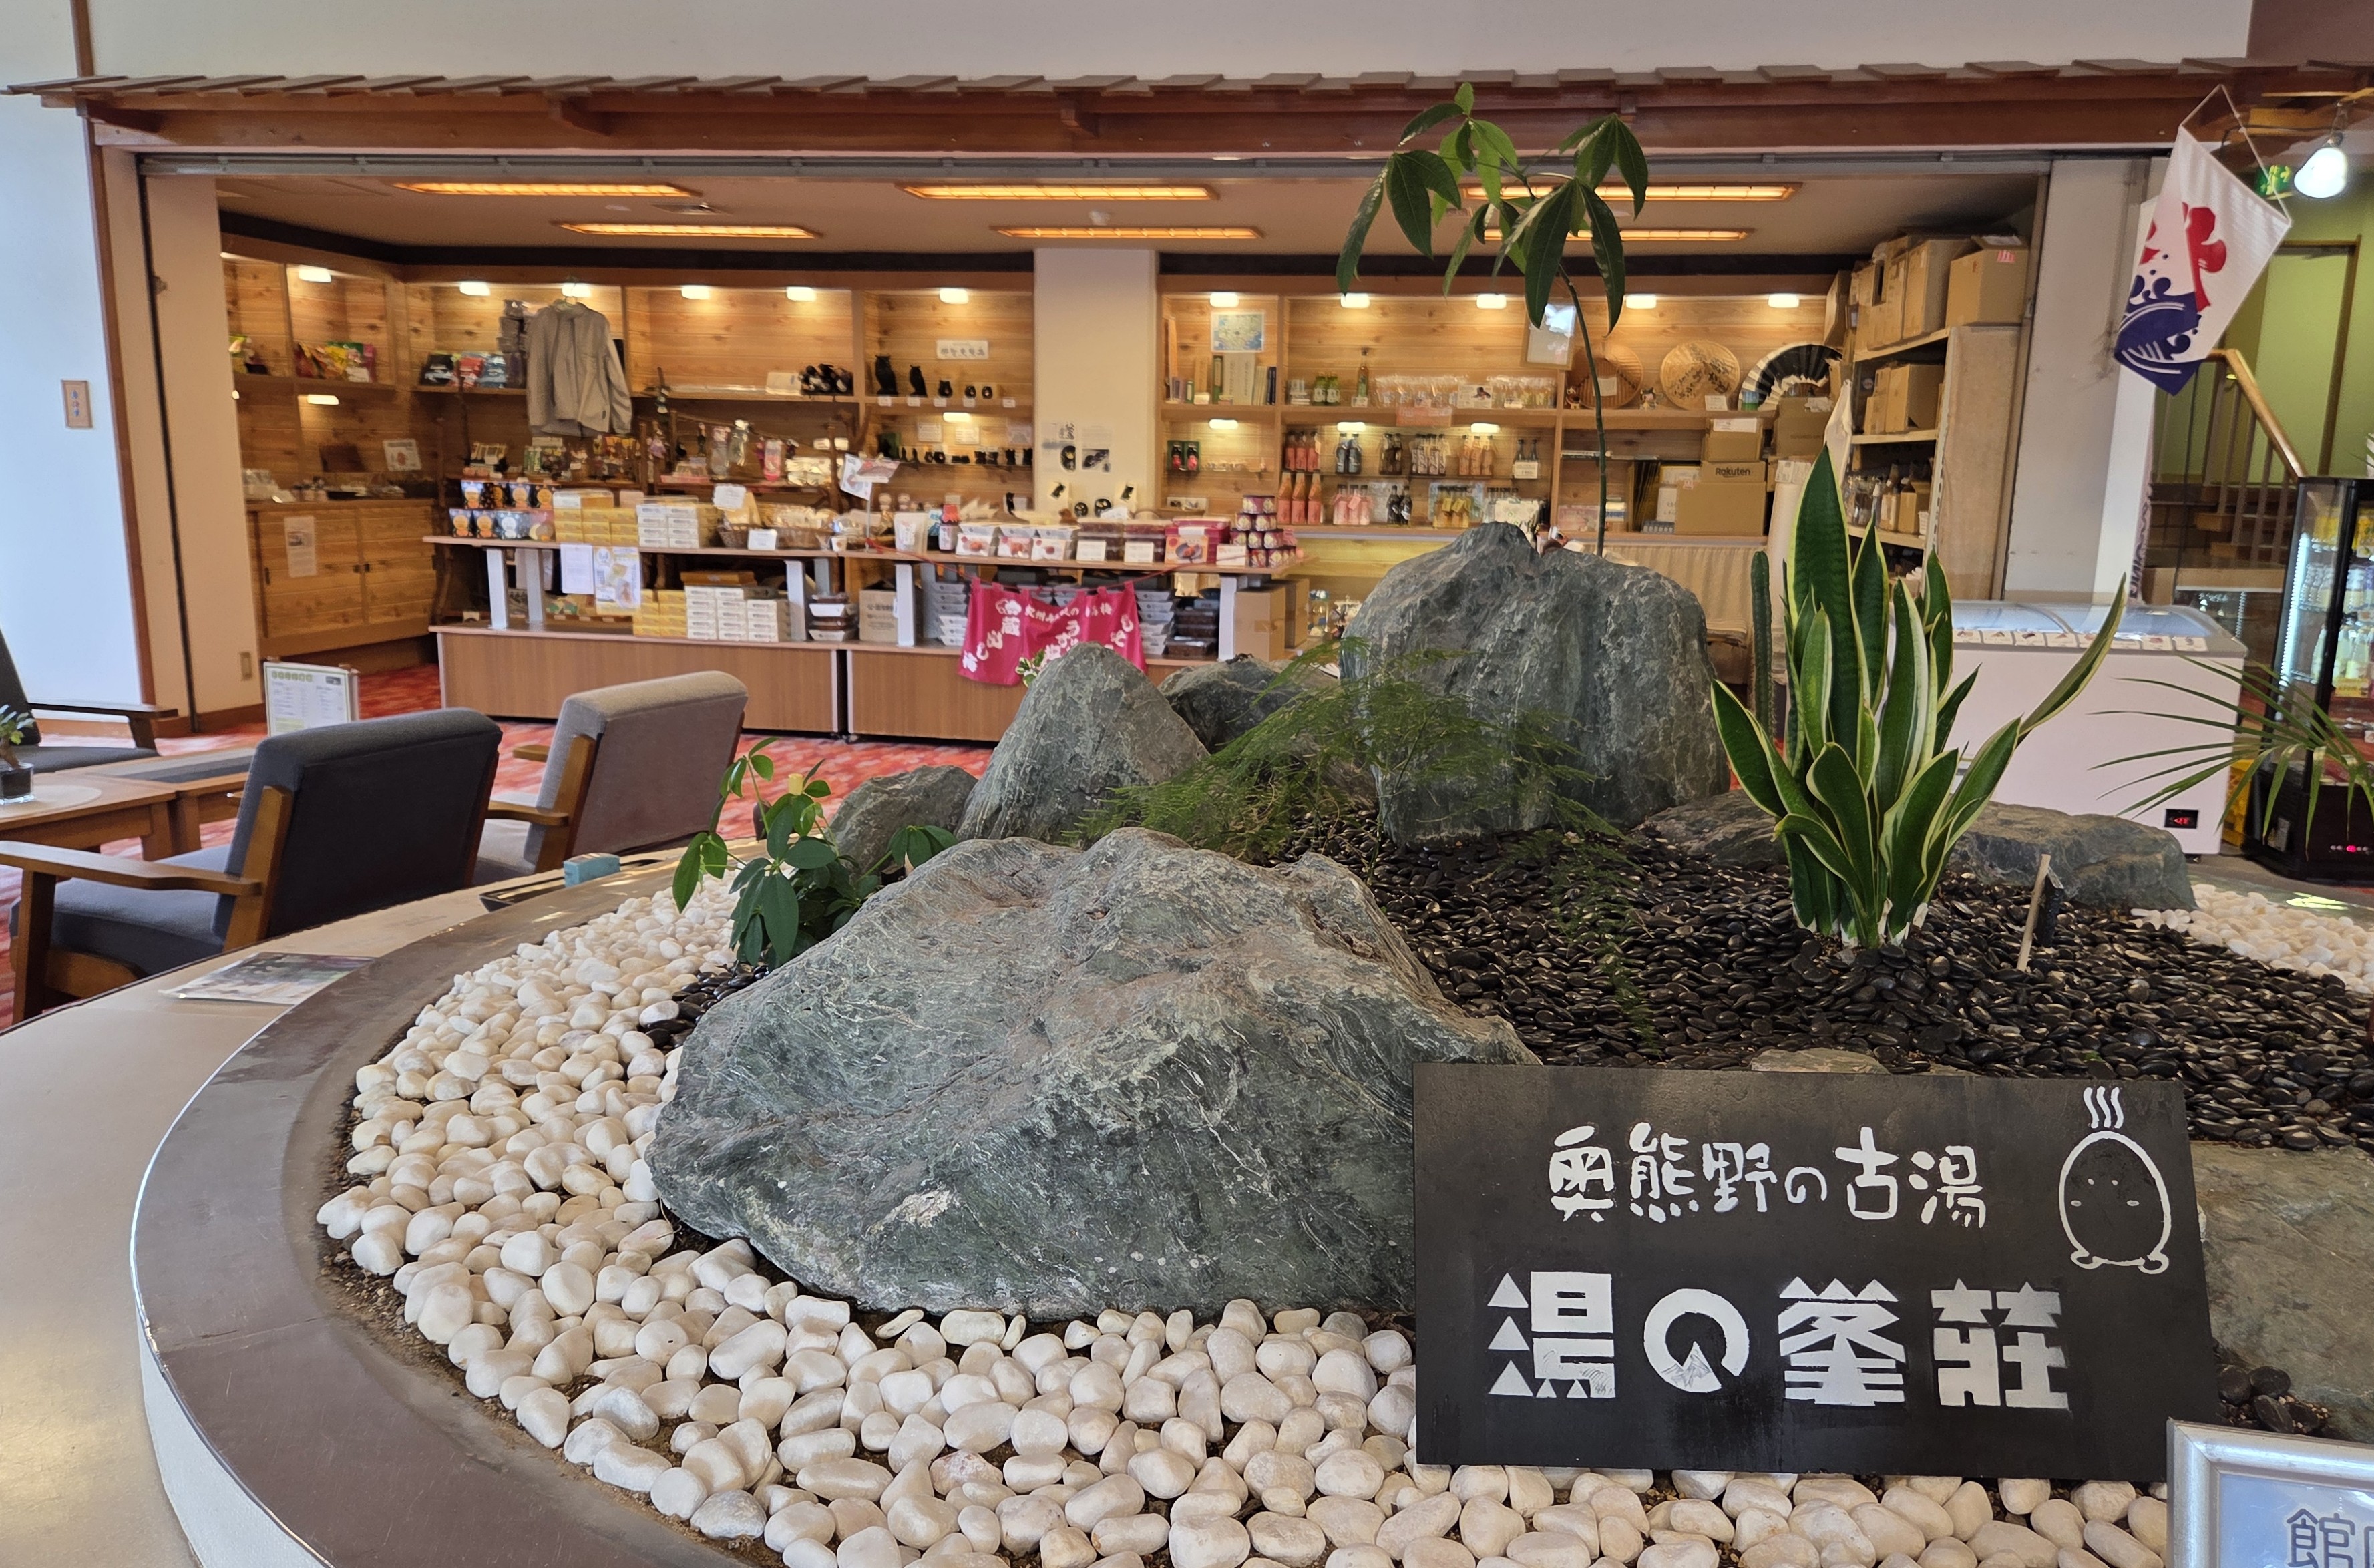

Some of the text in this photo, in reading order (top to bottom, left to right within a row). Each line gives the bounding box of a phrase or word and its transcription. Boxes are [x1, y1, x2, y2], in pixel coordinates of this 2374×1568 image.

[1716, 467, 1751, 478] Rakuten
[1549, 1121, 1987, 1229] 奥熊野の古湯
[2286, 1507, 2374, 1568] 館
